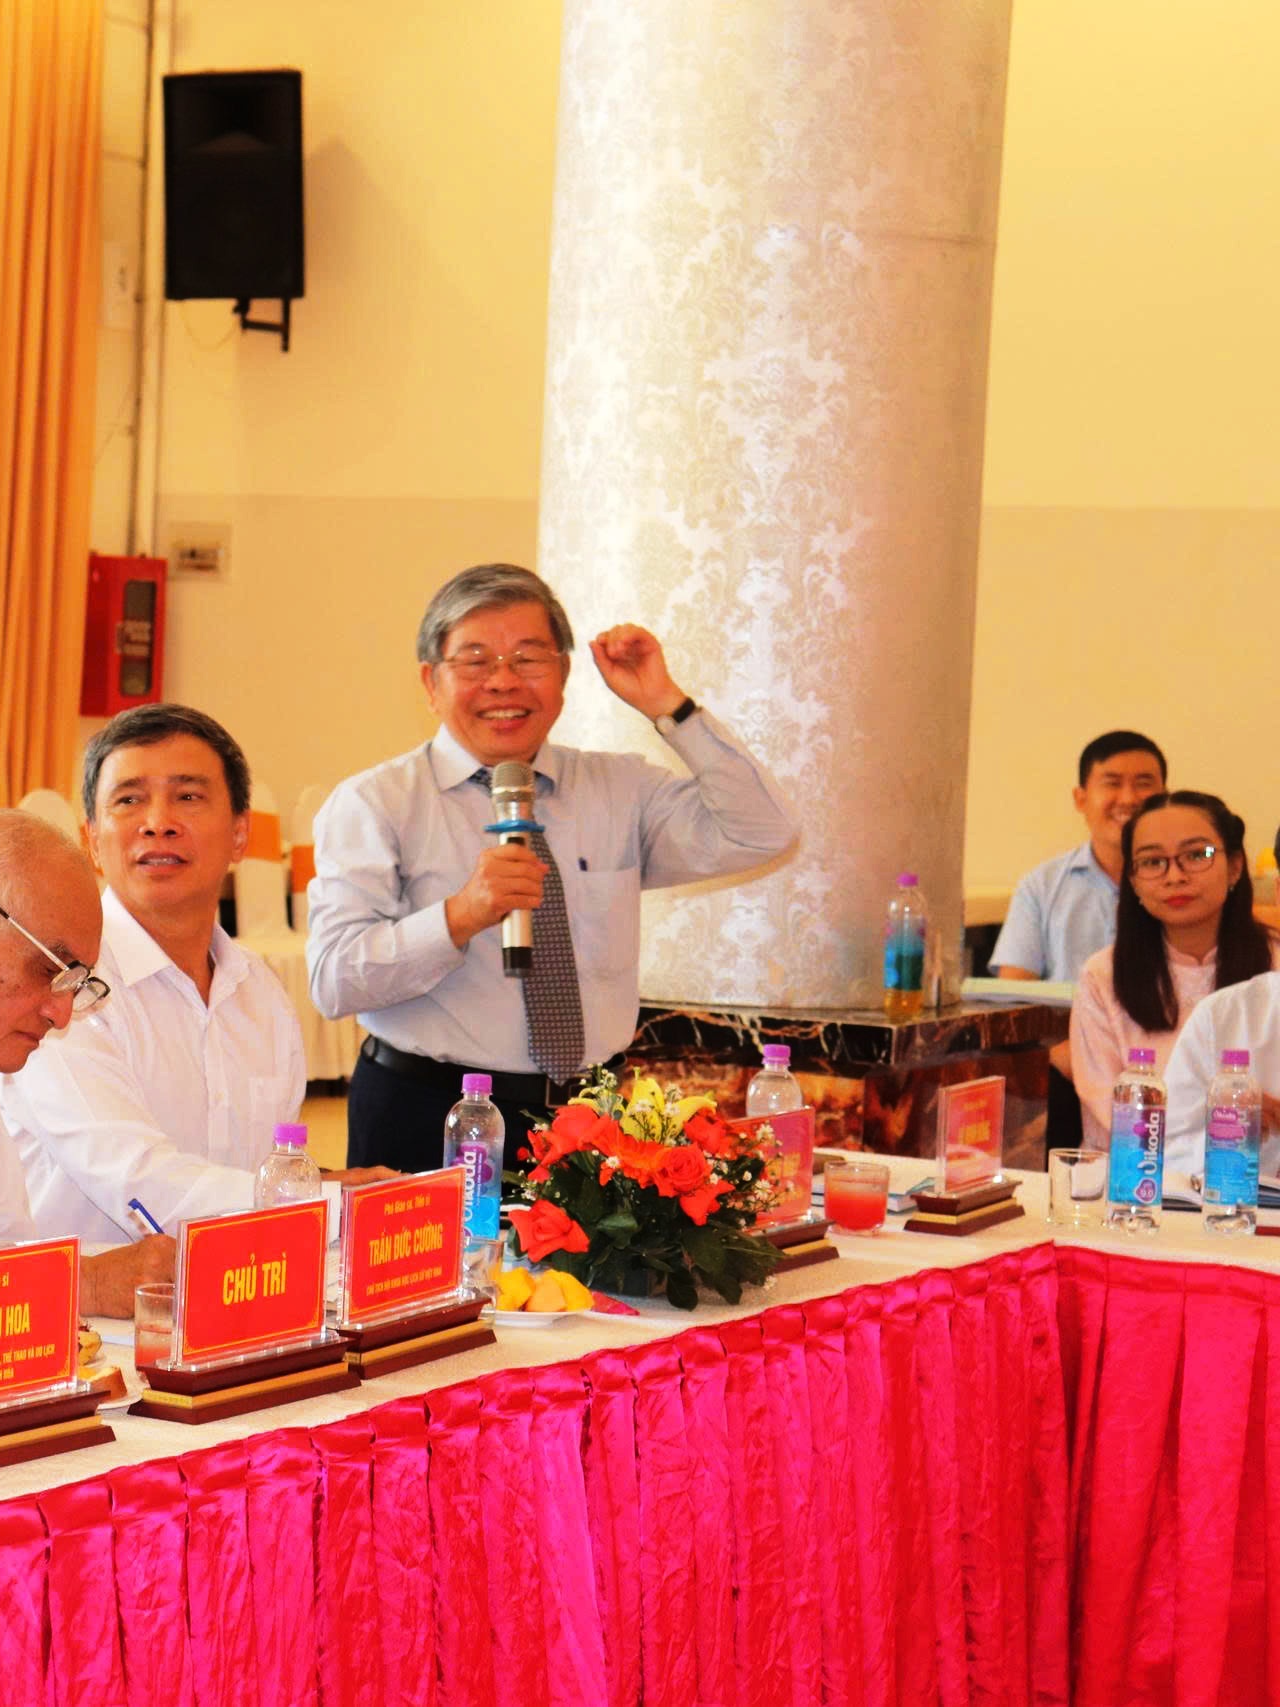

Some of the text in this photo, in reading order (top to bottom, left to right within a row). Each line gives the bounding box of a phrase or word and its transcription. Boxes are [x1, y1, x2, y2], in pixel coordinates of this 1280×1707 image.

[1137, 1112, 1160, 1175] Vikoda
[369, 1219, 443, 1267] TRẦN ĐỨC CƯỜNG
[223, 1252, 287, 1305] CHỦ TRÌ
[5, 1302, 31, 1336] HOA
